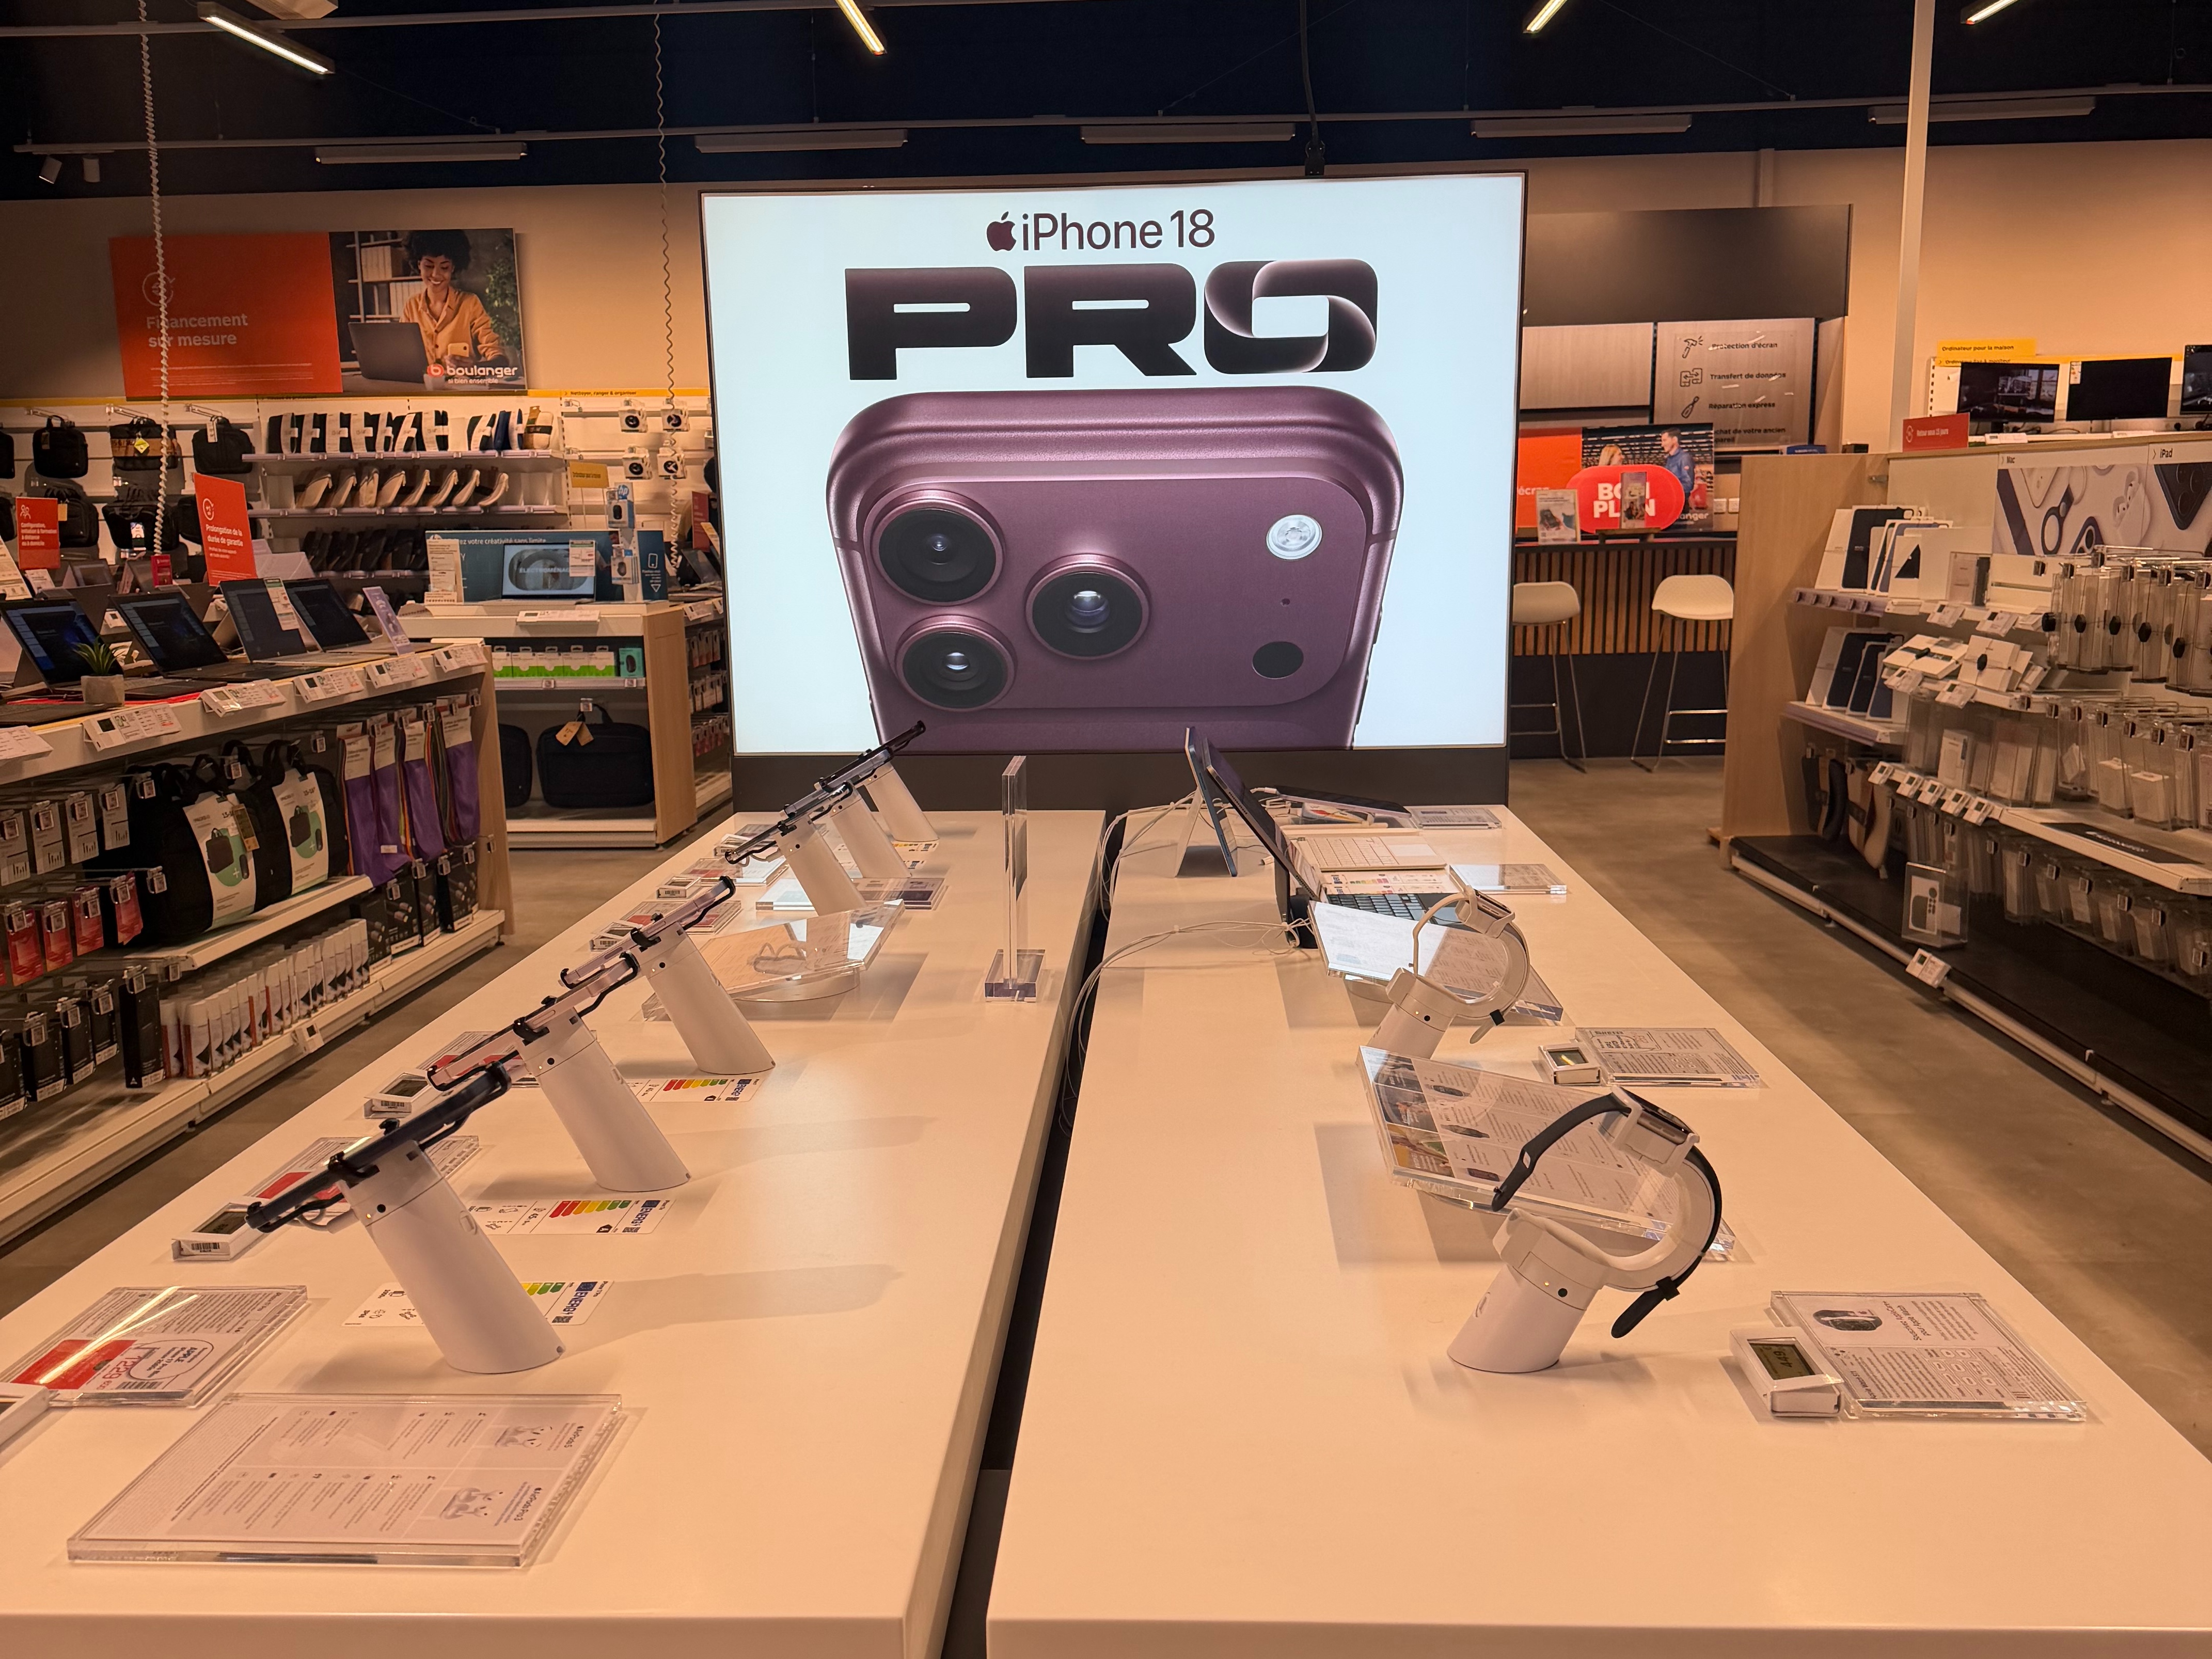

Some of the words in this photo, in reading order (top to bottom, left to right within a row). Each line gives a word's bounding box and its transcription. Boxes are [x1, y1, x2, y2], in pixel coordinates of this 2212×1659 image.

[1021, 213, 1162, 250] iPhone
[1170, 209, 1215, 248] 18
[146, 313, 248, 329] Fiancement
[845, 259, 1378, 380] PRO
[178, 333, 236, 346] mesure
[447, 365, 518, 377] boulanger
[2160, 448, 2173, 459] iPad
[1593, 499, 1655, 518] PLN
[631, 1208, 652, 1224] ENERG
[563, 1292, 588, 1312] ENERG
[1883, 1301, 1903, 1320] AppleCare+
[1897, 1305, 1910, 1316] Watch
[1908, 1317, 1921, 1326] Apple
[1900, 1321, 1922, 1340] Souscrivez
[1917, 1327, 1931, 1336] pour
[175, 1347, 197, 1362] APPLE
[102, 1356, 144, 1379] 1229
